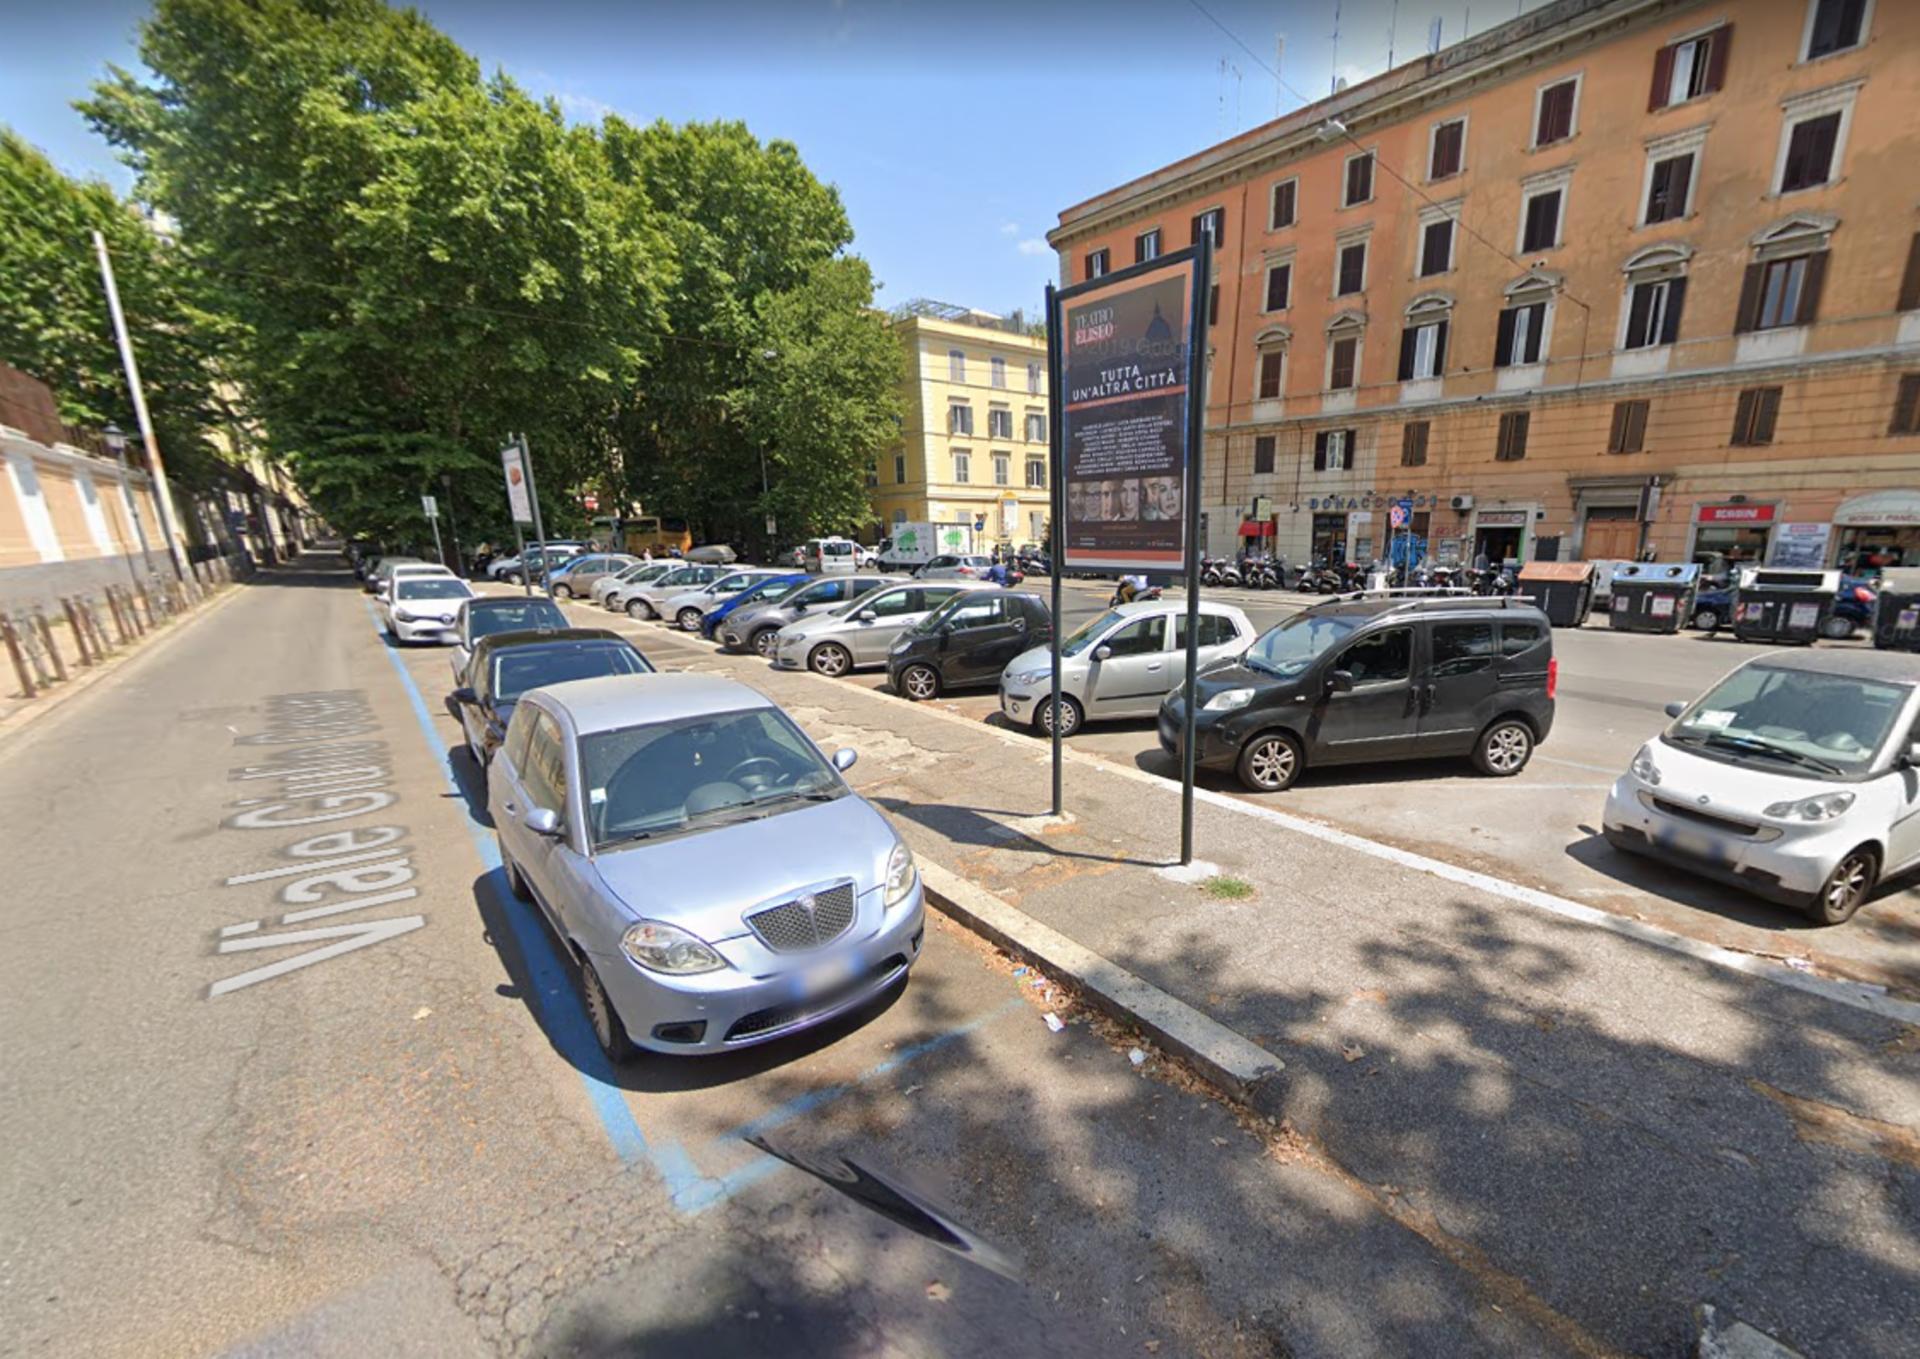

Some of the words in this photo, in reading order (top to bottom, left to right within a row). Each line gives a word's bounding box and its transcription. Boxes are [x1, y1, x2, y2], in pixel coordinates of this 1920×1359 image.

[1075, 307, 1114, 326] TEATRO
[1075, 323, 1114, 345] ELISEO
[1101, 365, 1140, 382] TUTTA
[1072, 381, 1130, 401] UN'ALTRA
[1135, 368, 1176, 389] CITTÀ
[1309, 496, 1437, 510] BONACCOSI
